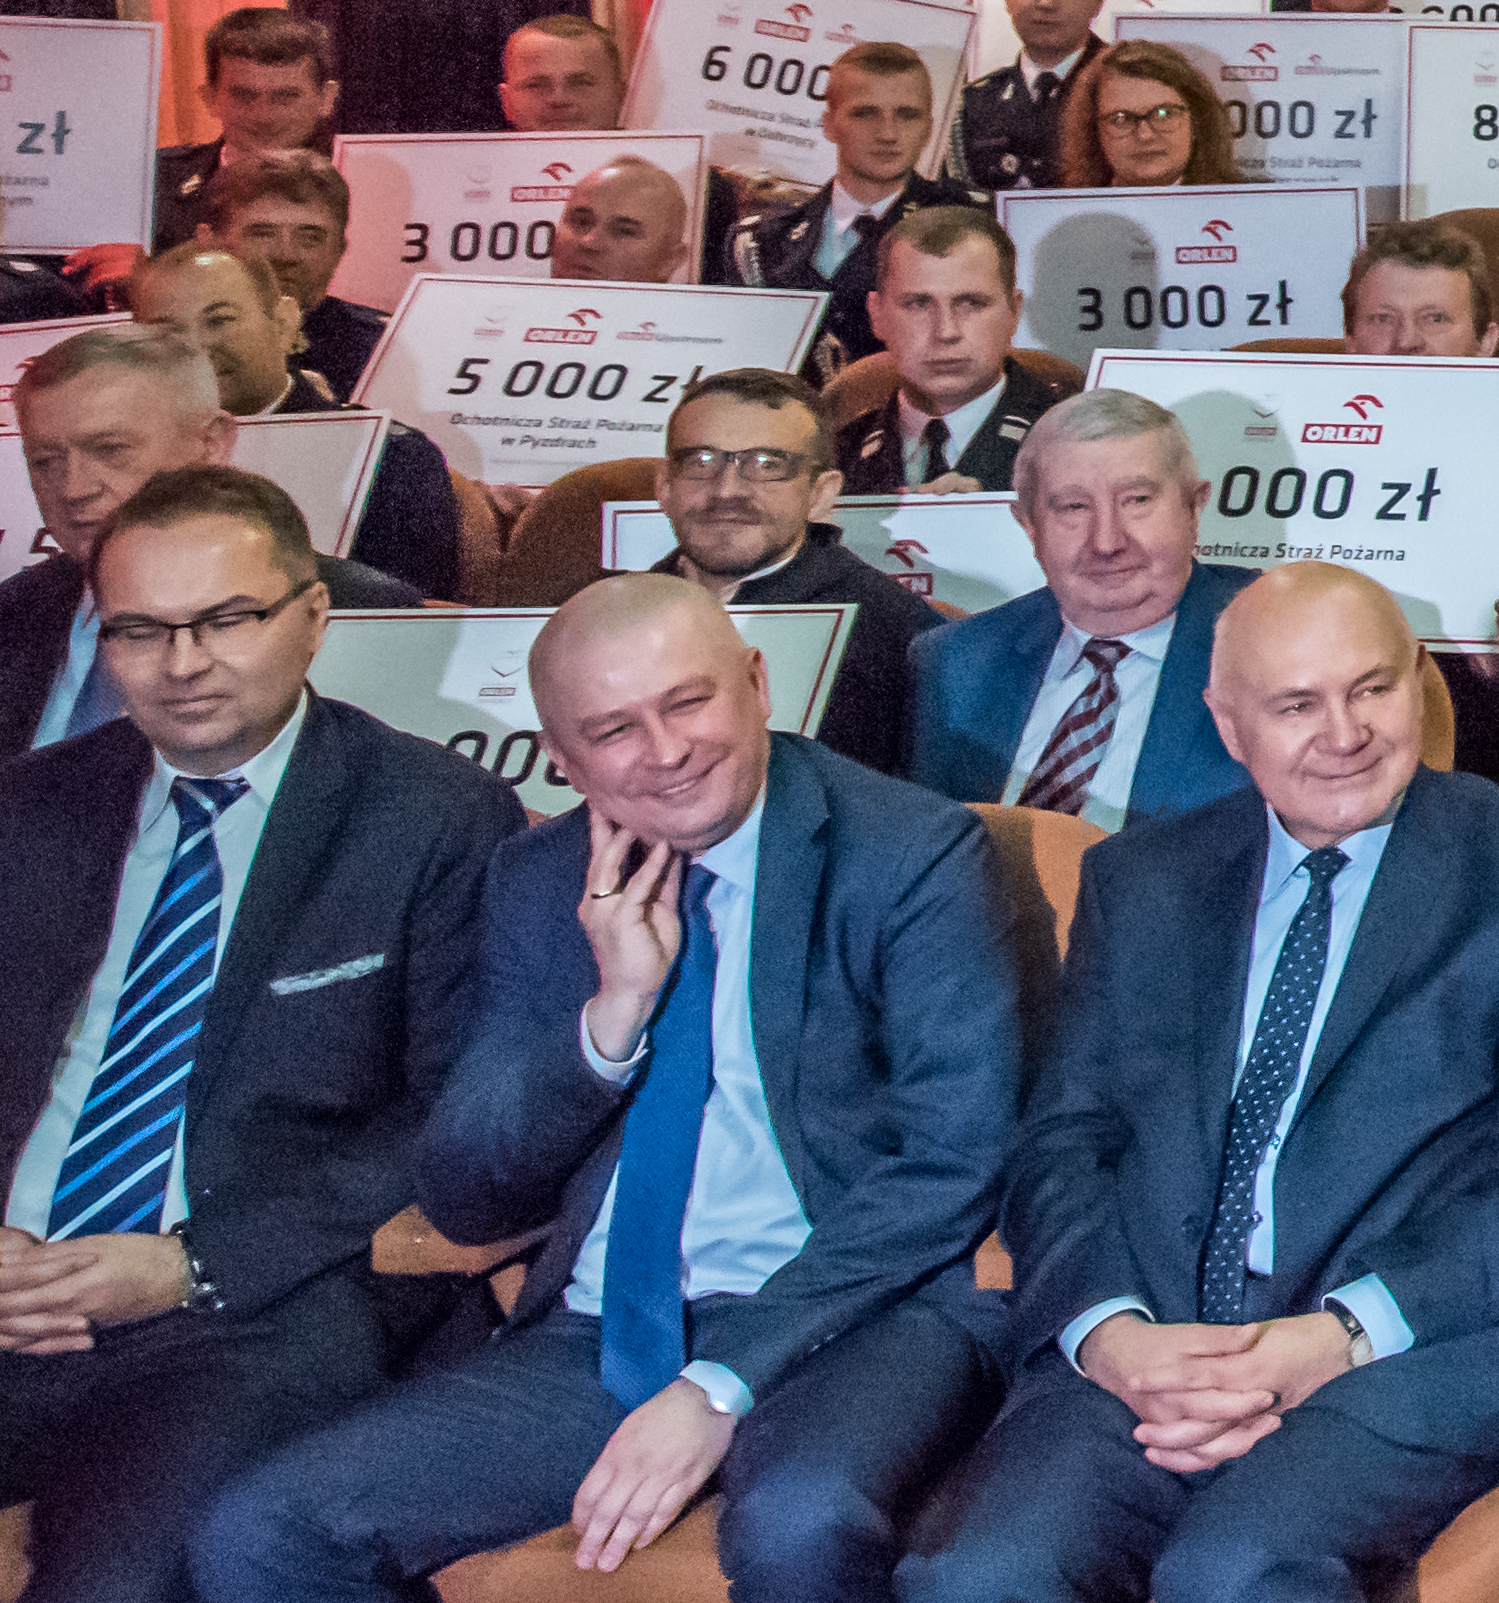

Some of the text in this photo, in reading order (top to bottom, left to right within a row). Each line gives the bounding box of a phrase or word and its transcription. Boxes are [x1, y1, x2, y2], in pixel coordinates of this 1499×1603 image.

[1474, 105, 1498, 141] 8
[1078, 280, 1293, 331] 3 000 zł
[448, 358, 703, 403] 5 000 zł
[1303, 426, 1380, 442] ORLEN
[1217, 466, 1440, 521] 000 zł
